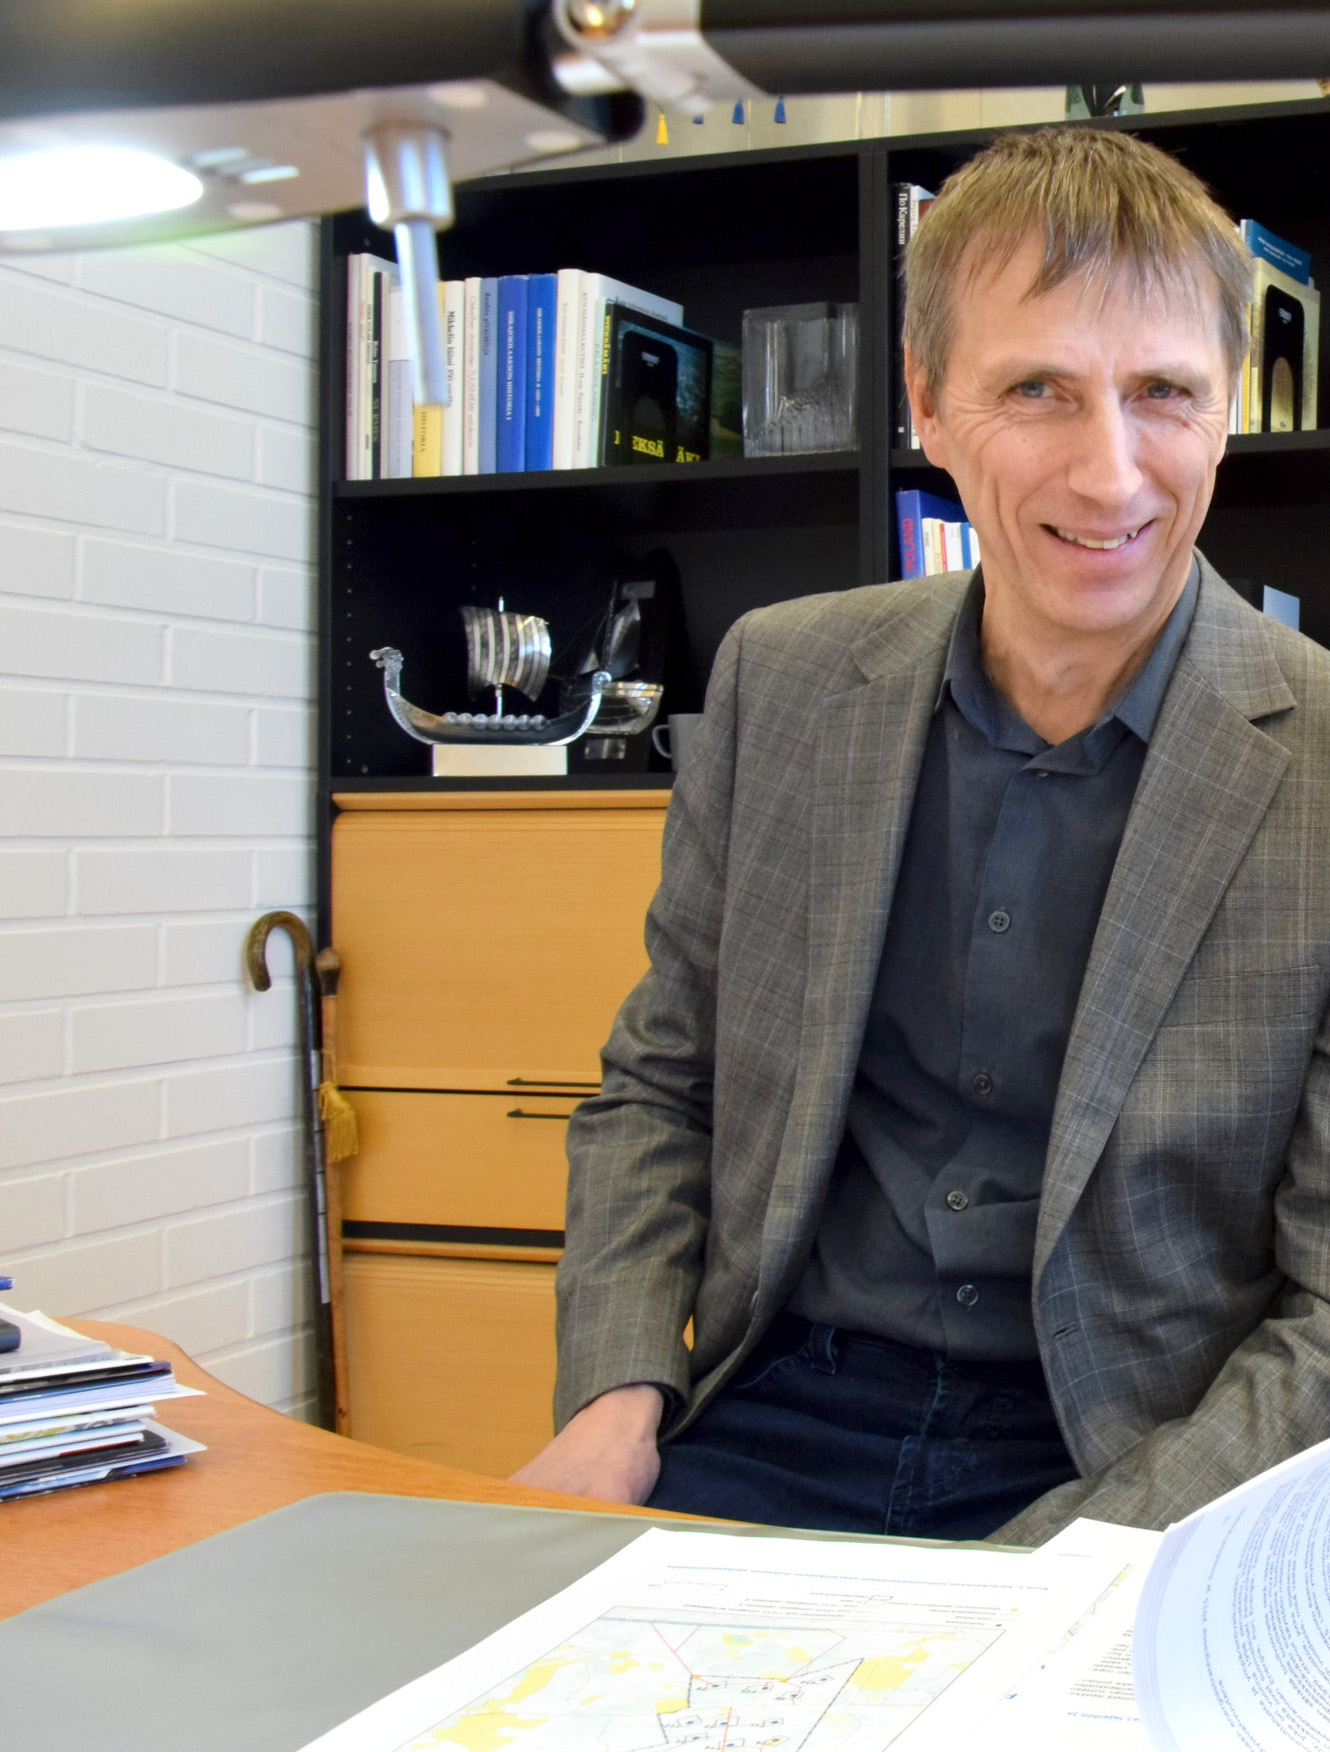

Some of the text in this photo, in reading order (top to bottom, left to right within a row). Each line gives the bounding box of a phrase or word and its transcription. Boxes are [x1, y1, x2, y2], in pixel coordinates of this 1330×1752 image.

[896, 192, 907, 245] По Карелии
[446, 310, 456, 345] Mikkelin
[902, 517, 916, 570] POLAND
